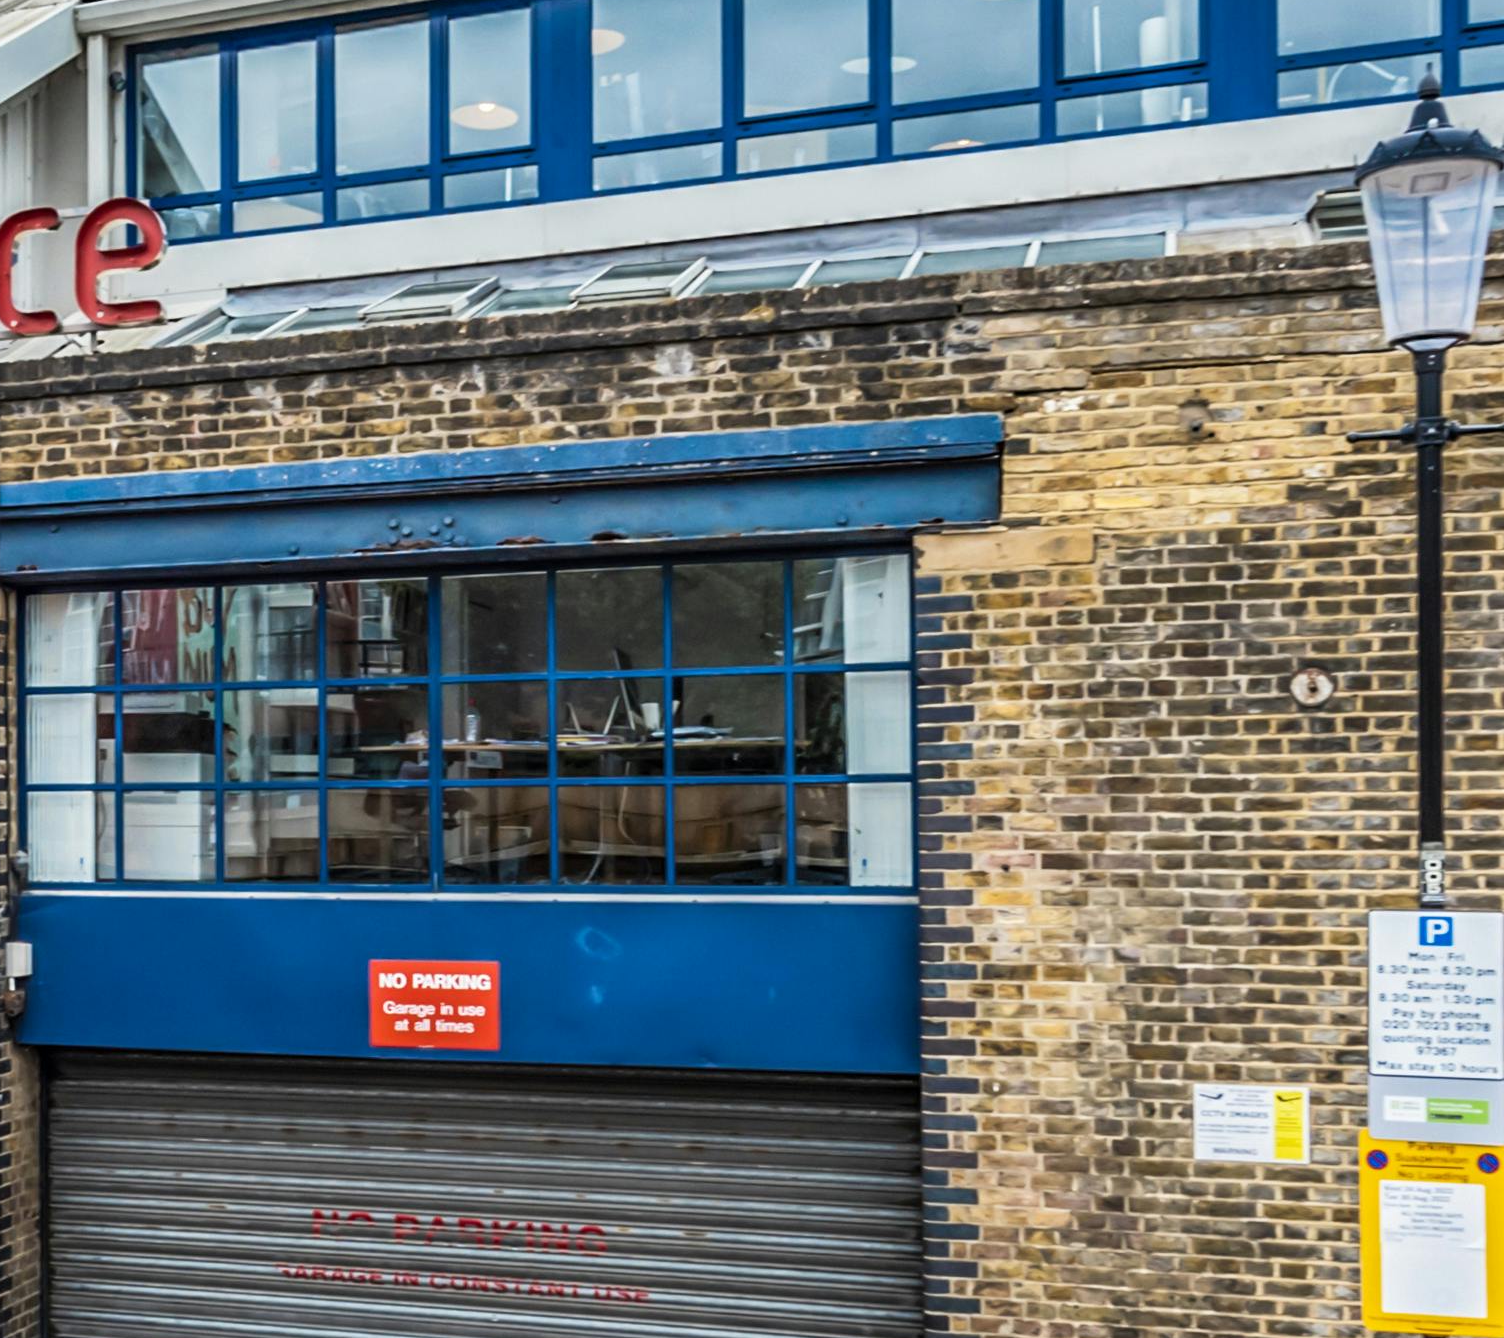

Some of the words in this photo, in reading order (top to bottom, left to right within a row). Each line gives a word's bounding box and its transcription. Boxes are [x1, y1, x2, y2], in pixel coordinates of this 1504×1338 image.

[1426, 919, 1450, 944] P
[378, 972, 407, 989] NO
[412, 973, 492, 990] PARKING
[383, 1001, 435, 1017] Garage
[440, 1002, 453, 1015] in
[457, 1005, 486, 1016] use
[394, 1019, 409, 1031] at
[414, 1019, 430, 1032] all
[435, 1019, 475, 1033] times
[394, 1213, 608, 1257] PARKING
[393, 1272, 420, 1286] IN
